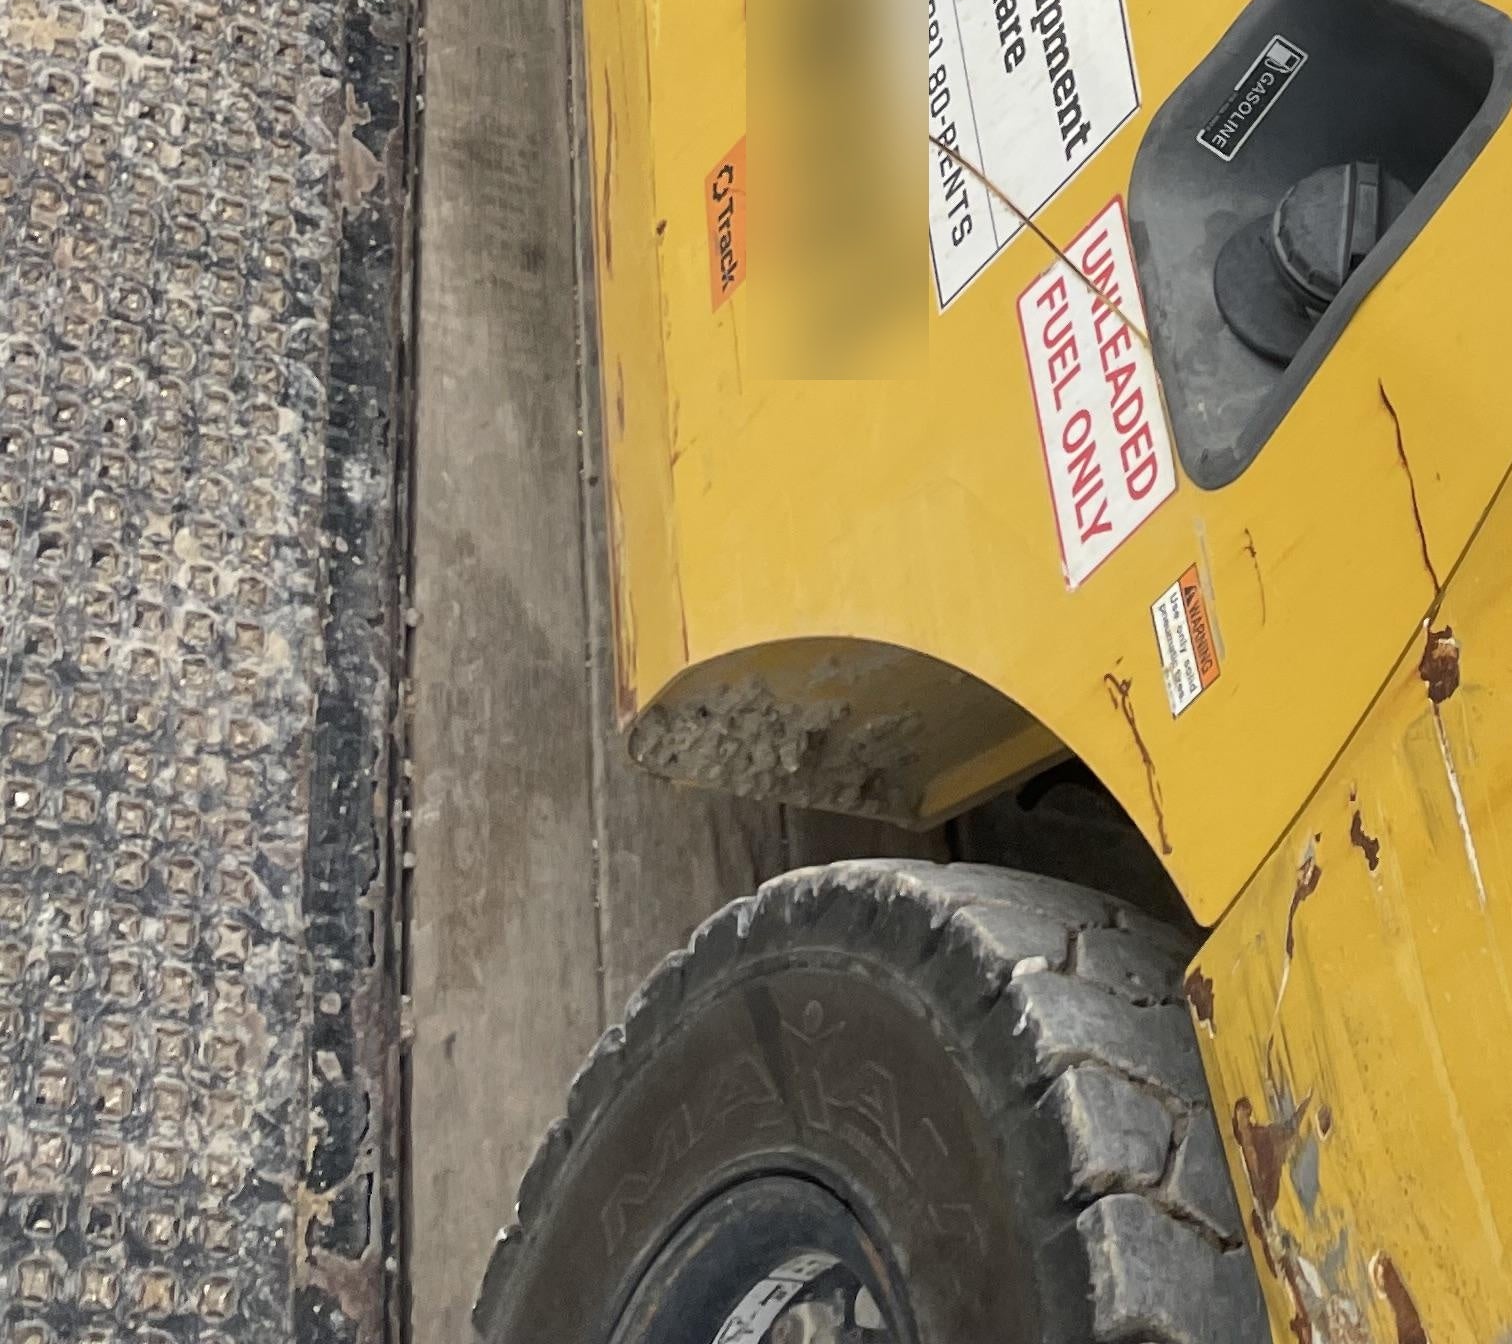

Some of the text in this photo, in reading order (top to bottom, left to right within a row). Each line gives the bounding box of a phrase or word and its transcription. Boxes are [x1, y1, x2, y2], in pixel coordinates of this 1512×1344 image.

[928, 62, 973, 250] 80-RENTS
[1212, 72, 1275, 148] GASOLINE
[718, 195, 737, 292] Track
[1034, 274, 1113, 544] FUEL ONLY
[1079, 227, 1160, 508] UNLEADED
[1169, 590, 1181, 620] Use
[1187, 598, 1213, 674] WARNING
